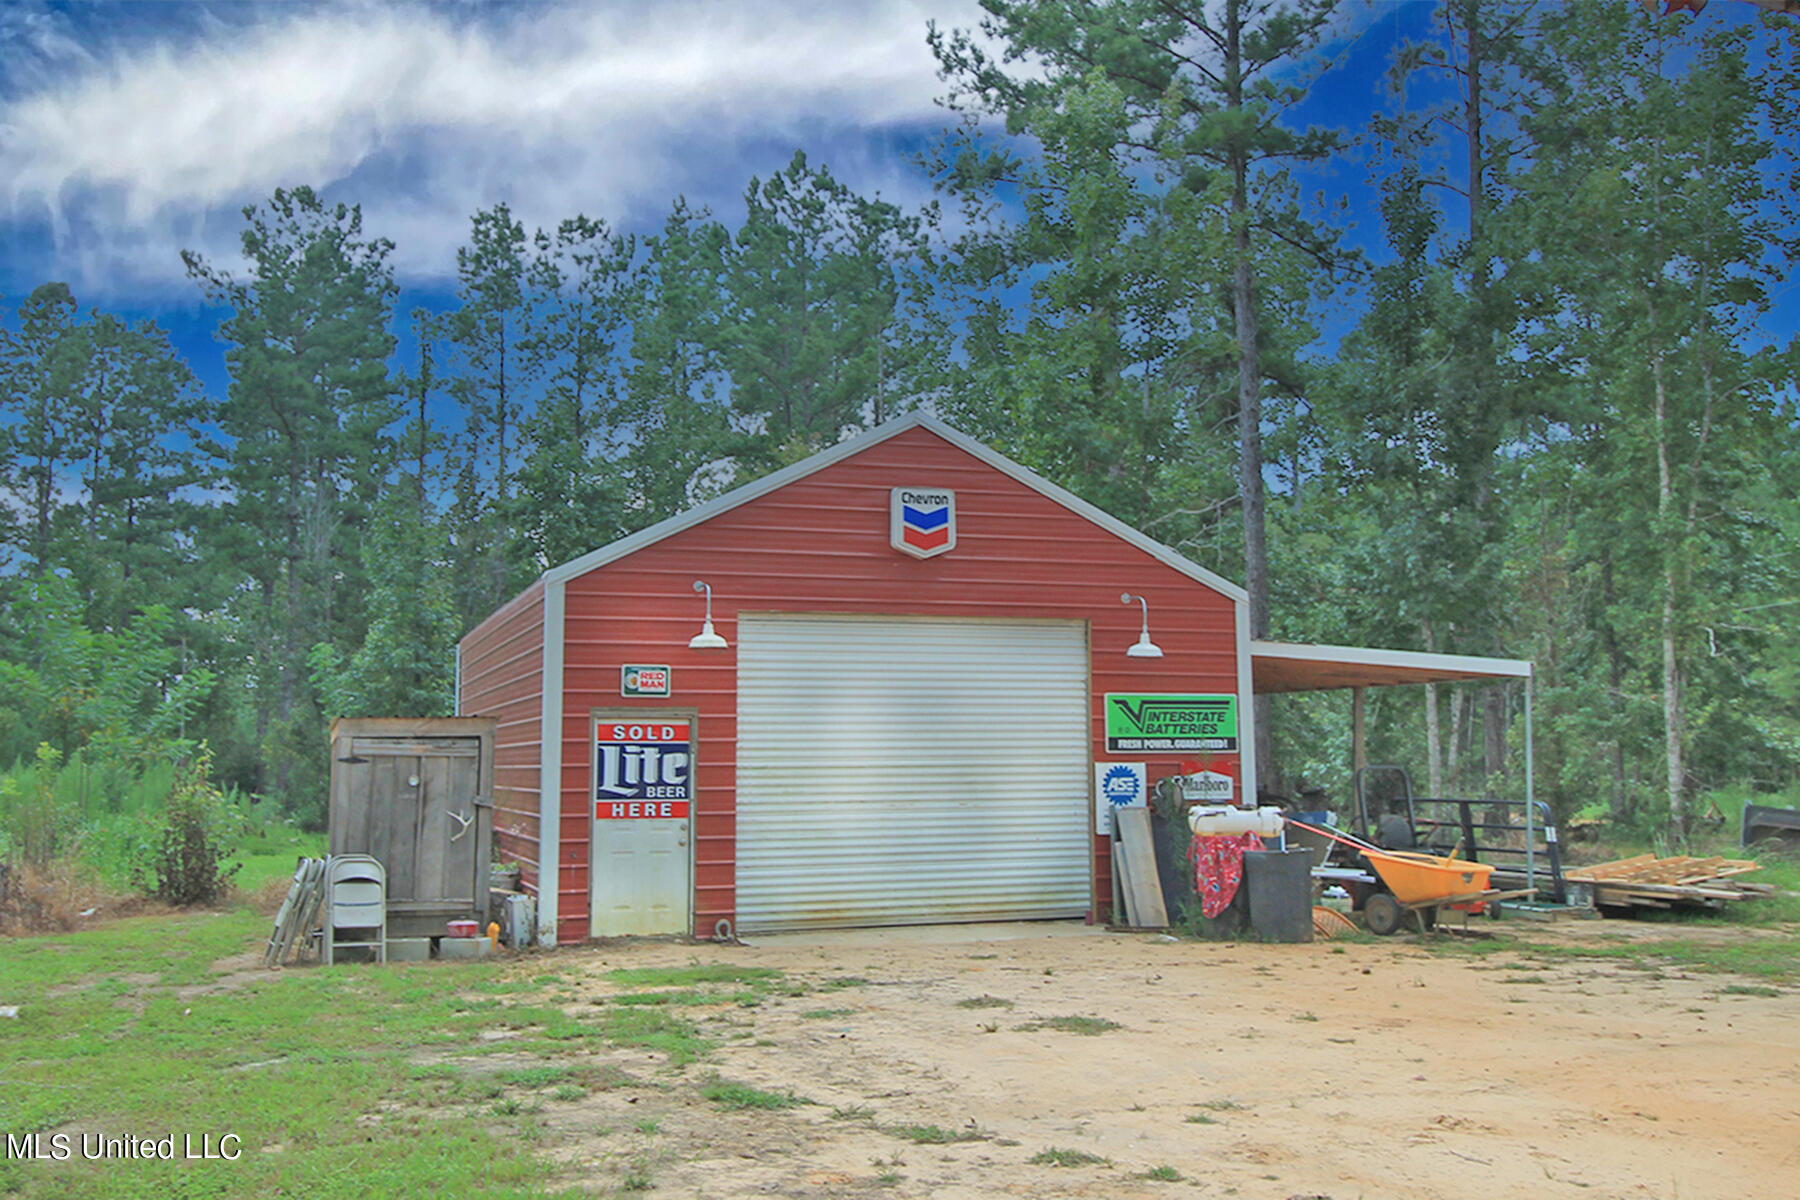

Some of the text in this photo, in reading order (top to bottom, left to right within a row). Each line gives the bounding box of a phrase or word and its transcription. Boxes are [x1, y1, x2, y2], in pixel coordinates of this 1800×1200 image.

[901, 491, 949, 505] Chevron
[640, 672, 665, 680] RED
[640, 680, 665, 688] MAN
[1148, 711, 1226, 722] INTERSTATE
[613, 725, 674, 740] SOLD
[1146, 723, 1218, 735] BATTERIES
[598, 745, 689, 797] Lite
[1107, 777, 1136, 791] ASE
[646, 786, 686, 798] BEER
[611, 803, 672, 817] HERE
